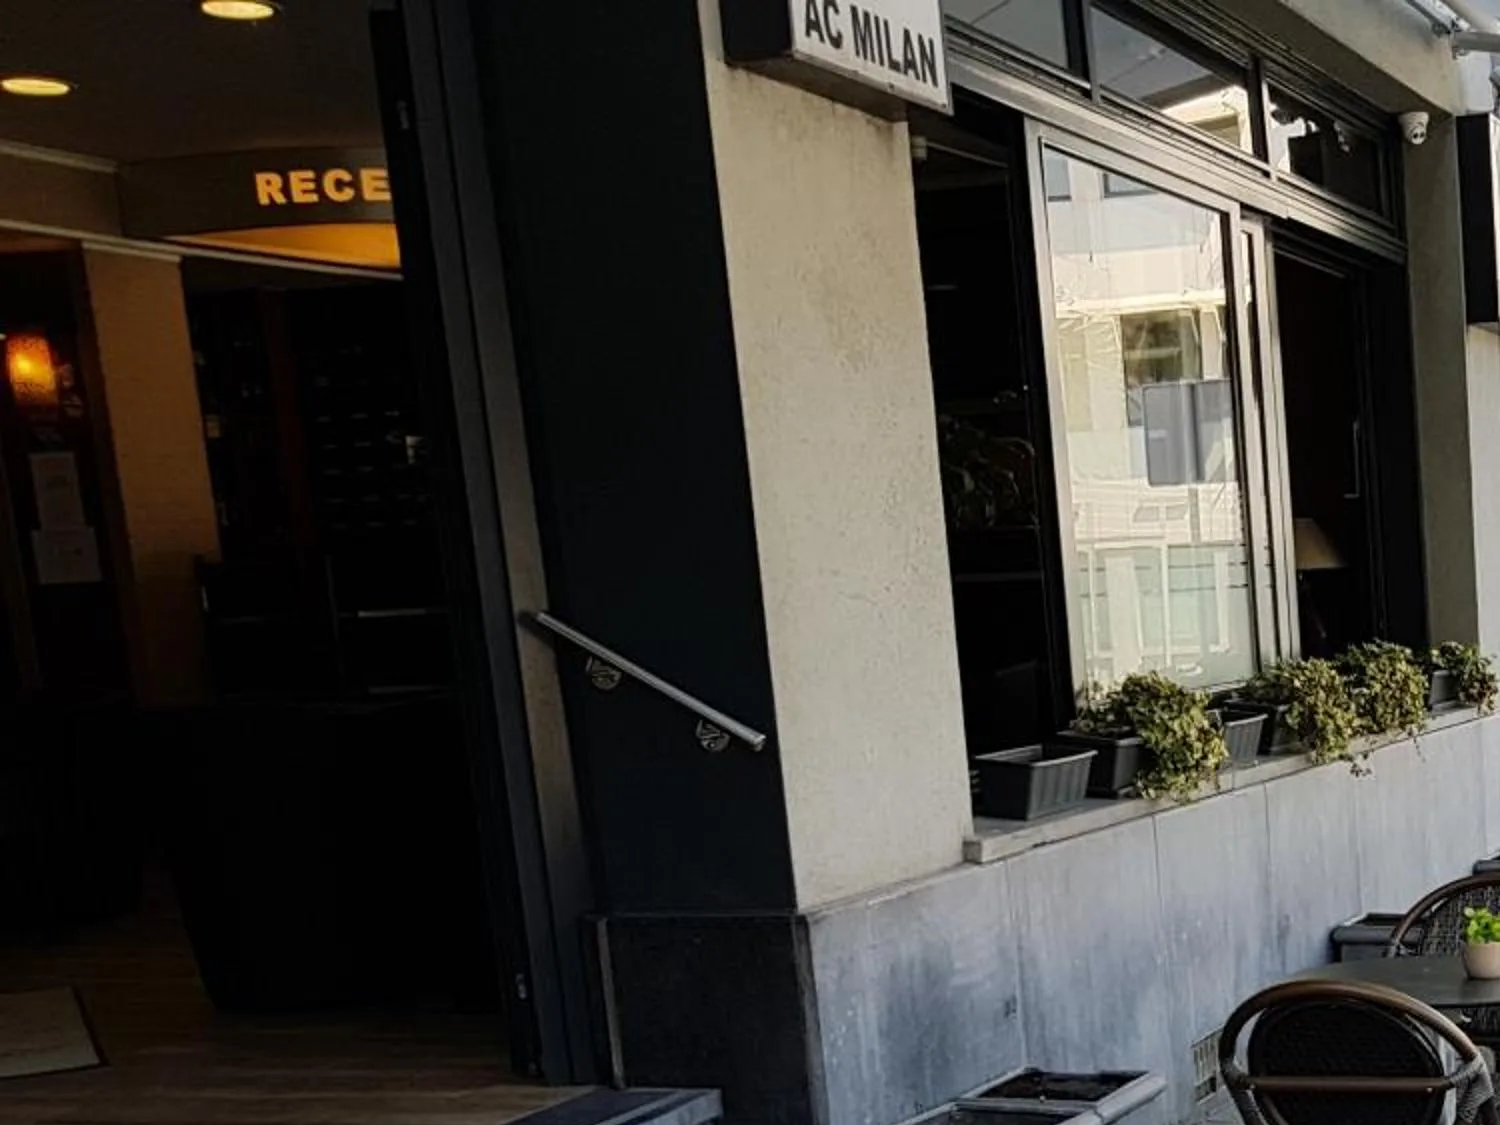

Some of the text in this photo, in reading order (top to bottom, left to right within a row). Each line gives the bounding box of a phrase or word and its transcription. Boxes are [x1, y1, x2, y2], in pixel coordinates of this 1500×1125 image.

[805, 0, 938, 88] AC MILAN
[255, 167, 392, 206] RECE
